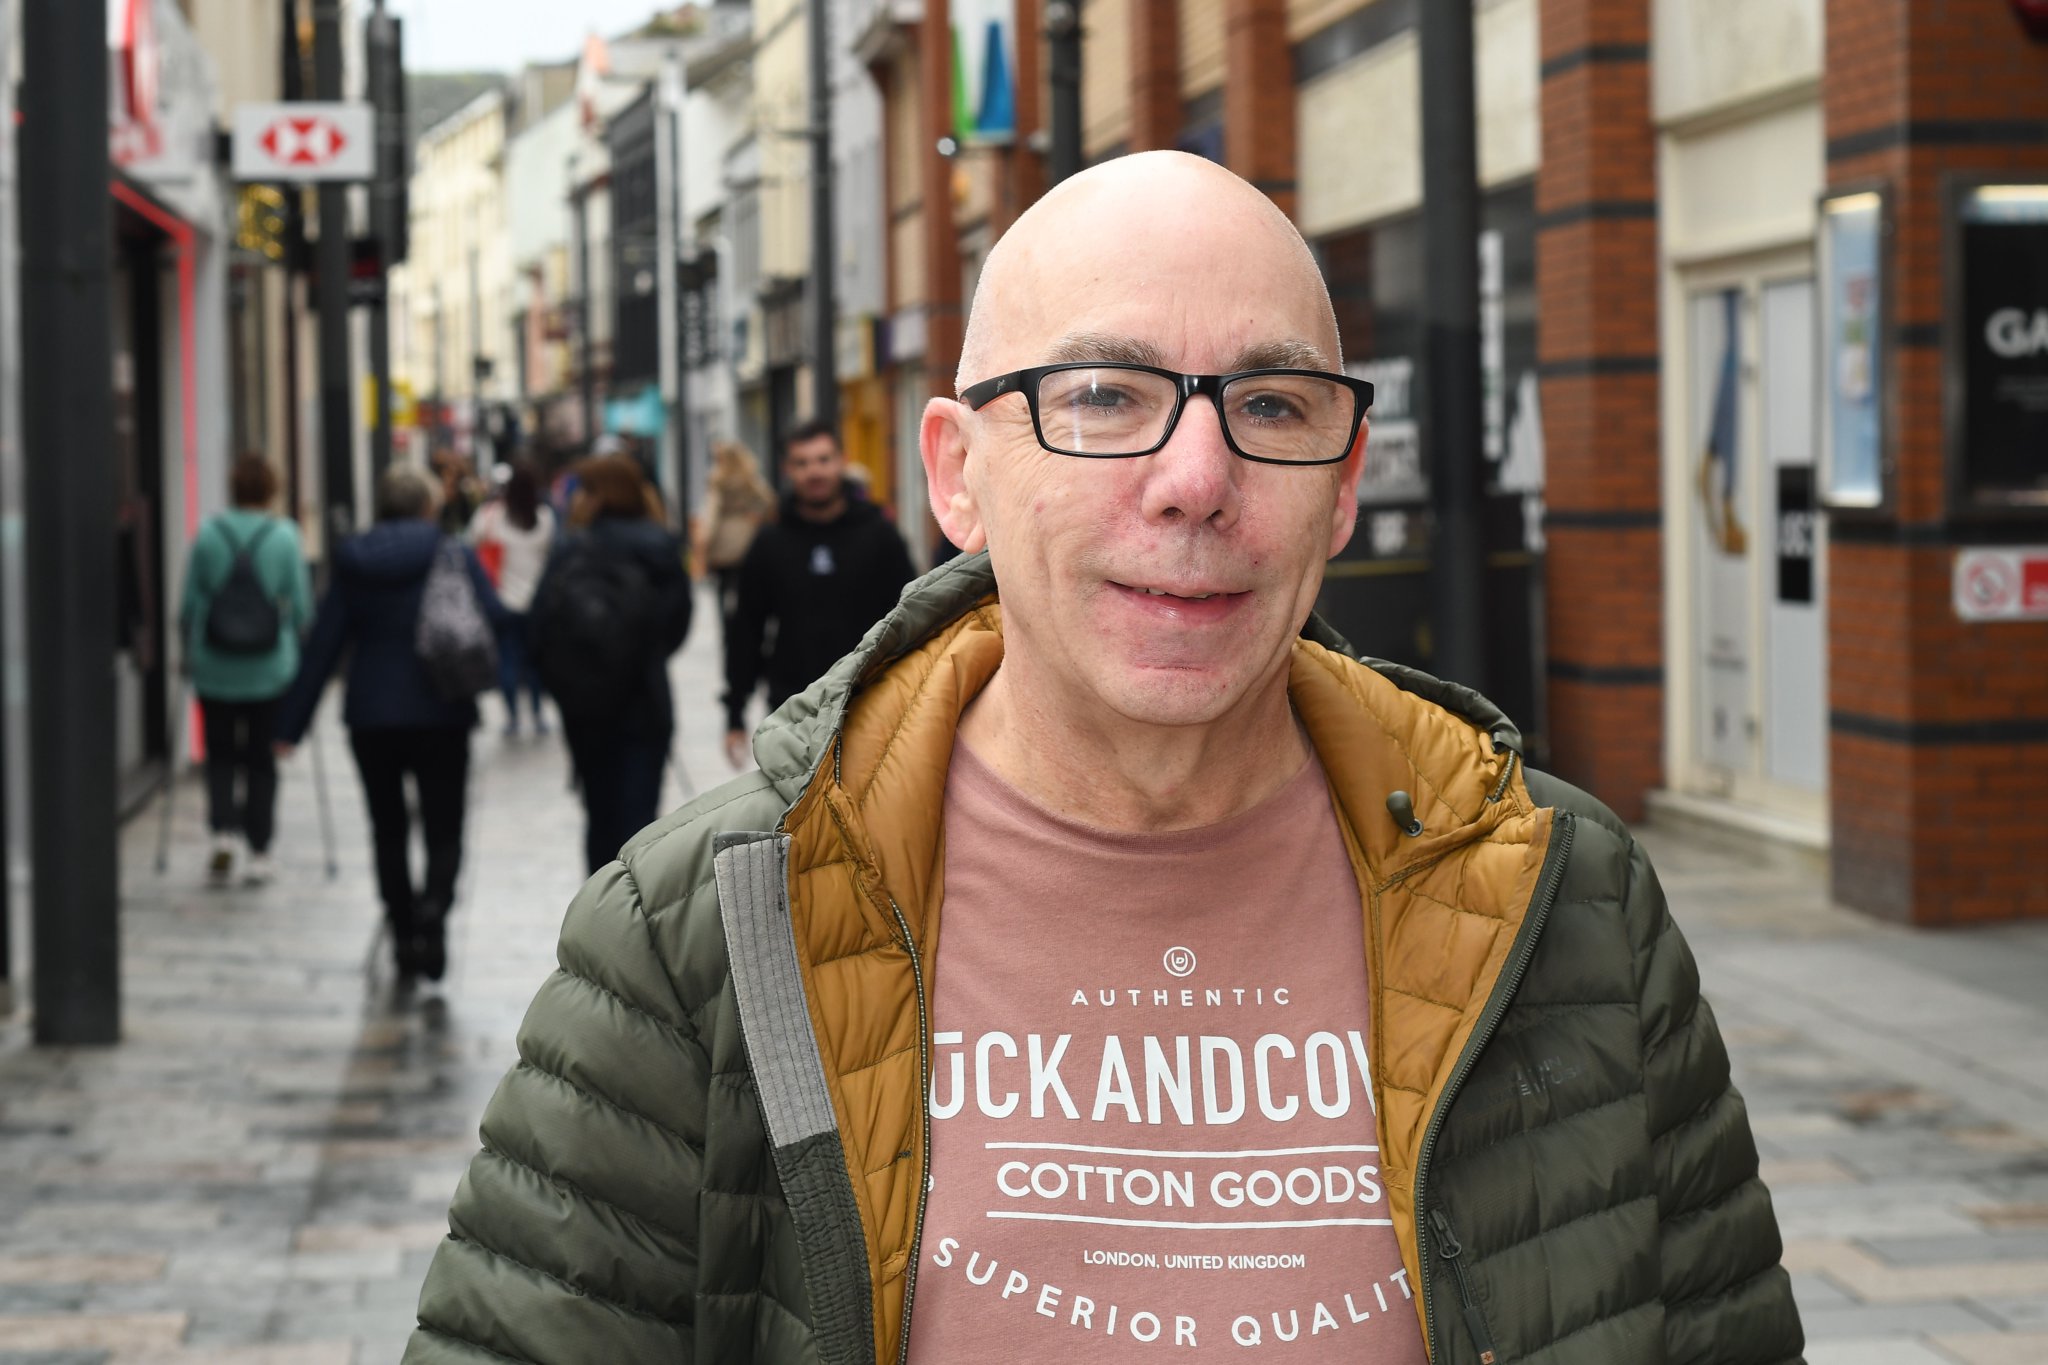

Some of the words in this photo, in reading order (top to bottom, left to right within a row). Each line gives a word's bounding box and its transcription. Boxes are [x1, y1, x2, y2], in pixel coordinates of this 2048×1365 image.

[1071, 988, 1289, 1007] AUTHENTIC
[997, 1161, 1195, 1208] COTTON
[1210, 1165, 1381, 1208] GOODS
[1083, 1249, 1160, 1269] LONDON,
[1164, 1254, 1224, 1270] UNITED
[1227, 1254, 1305, 1270] KINGDOM
[932, 1237, 1198, 1348] SUPERIOR
[1230, 1268, 1411, 1347] QUALIT
